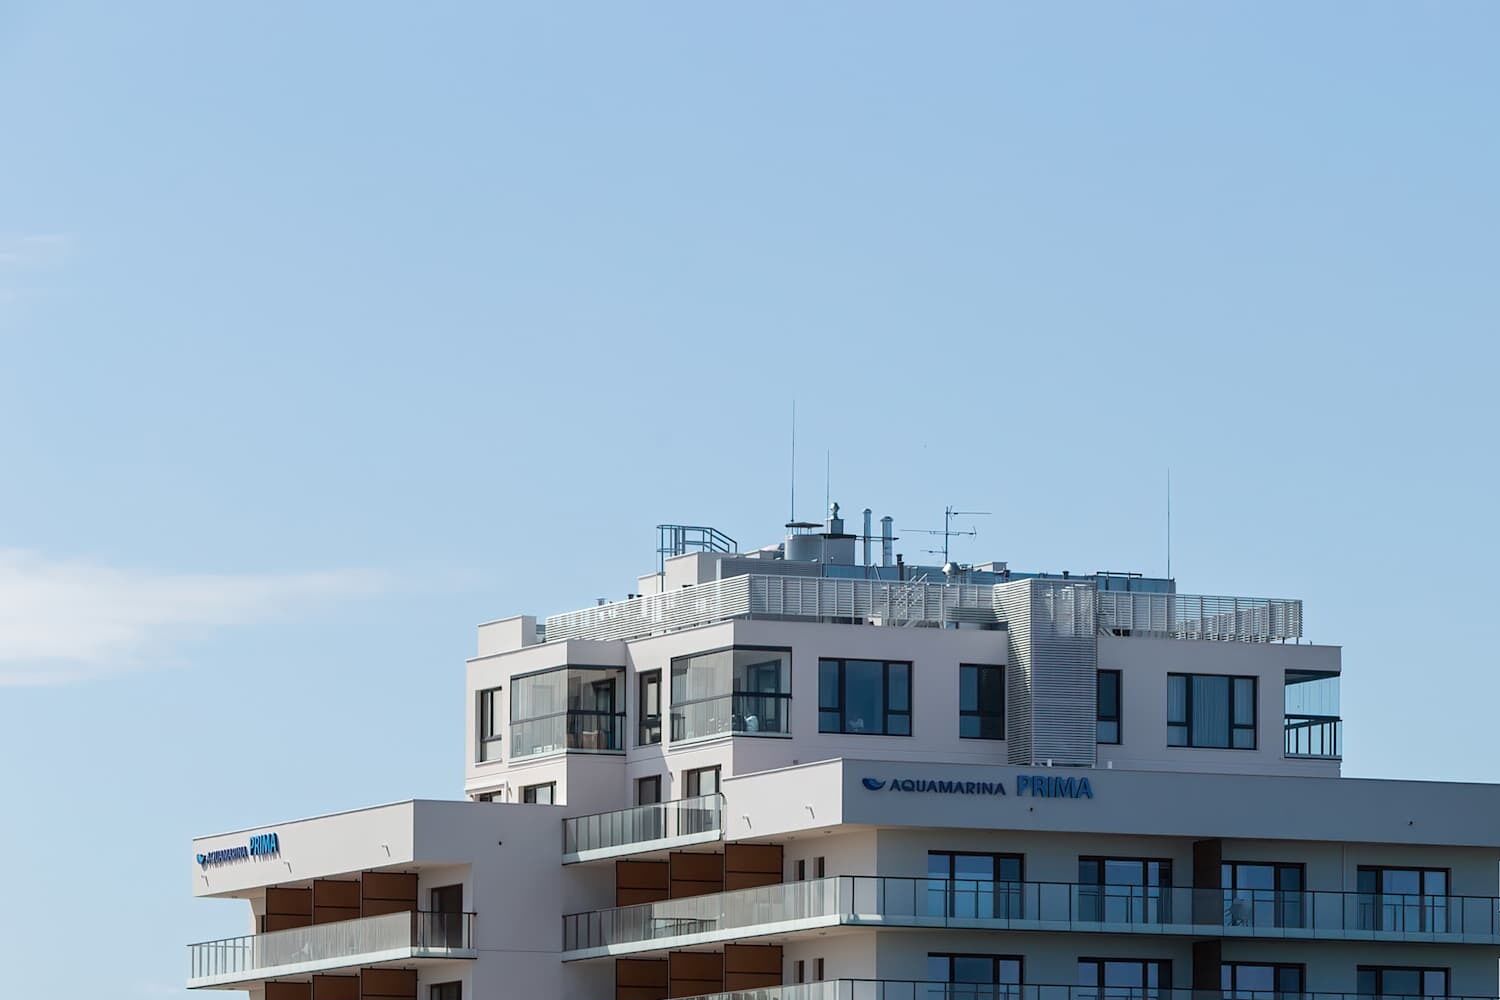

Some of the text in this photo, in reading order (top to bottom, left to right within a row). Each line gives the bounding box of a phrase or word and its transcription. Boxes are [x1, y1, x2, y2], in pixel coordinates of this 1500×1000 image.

[890, 775, 1093, 799] AQUAMARINA PRIMA
[249, 832, 279, 857] PRIMA
